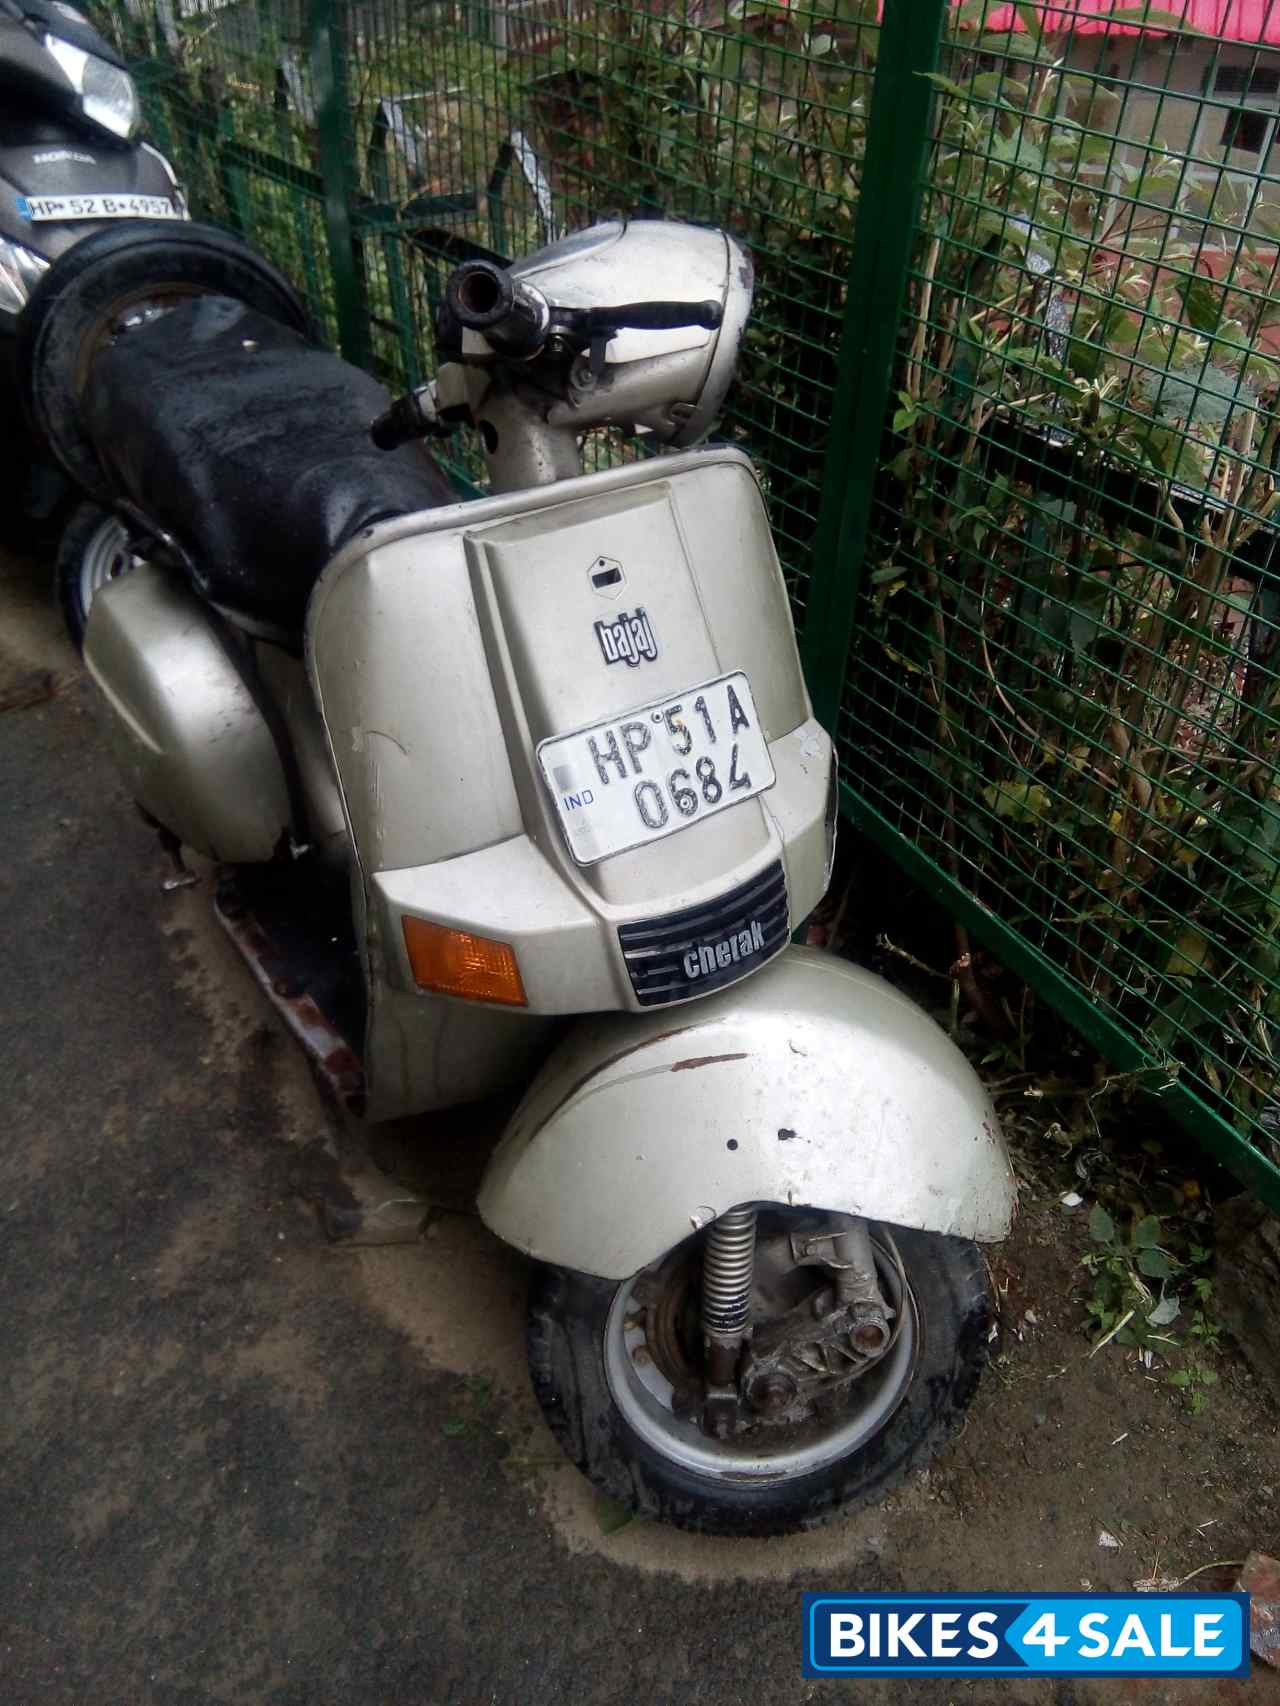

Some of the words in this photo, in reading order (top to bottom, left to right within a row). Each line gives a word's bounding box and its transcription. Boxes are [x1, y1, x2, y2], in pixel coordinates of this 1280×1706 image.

[595, 608, 659, 667] bajaj
[587, 721, 652, 785] HP
[564, 789, 595, 811] IND
[633, 744, 752, 829] 0684
